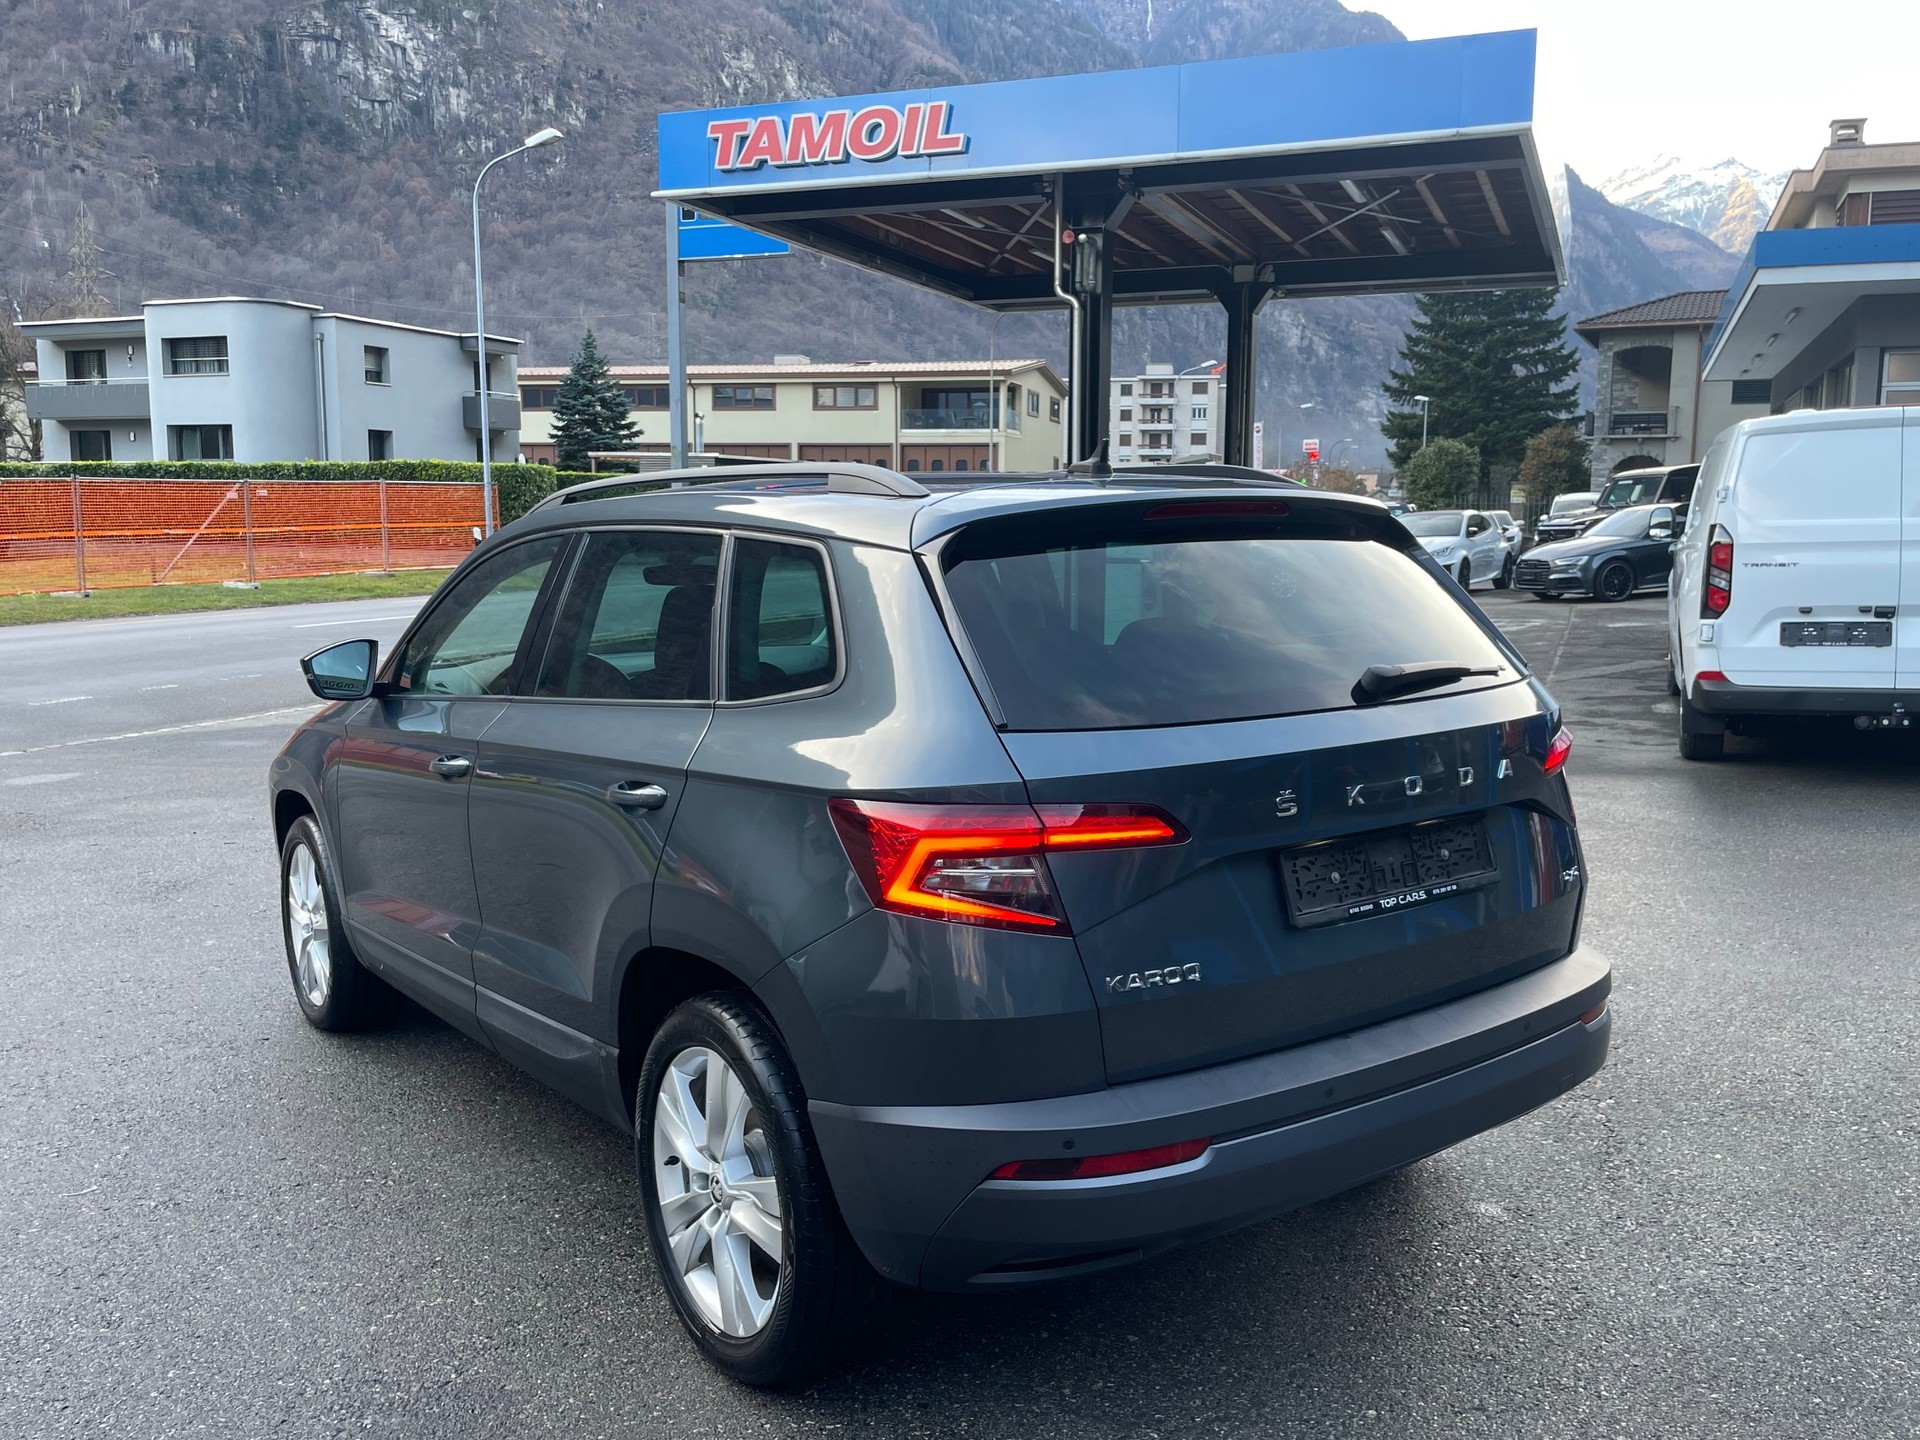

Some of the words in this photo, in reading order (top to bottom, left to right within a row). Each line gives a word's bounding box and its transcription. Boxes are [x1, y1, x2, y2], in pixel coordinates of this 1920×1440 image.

[707, 101, 968, 171] TAMOIL
[1379, 897, 1398, 909] TOP
[1105, 962, 1201, 994] KAROQ
